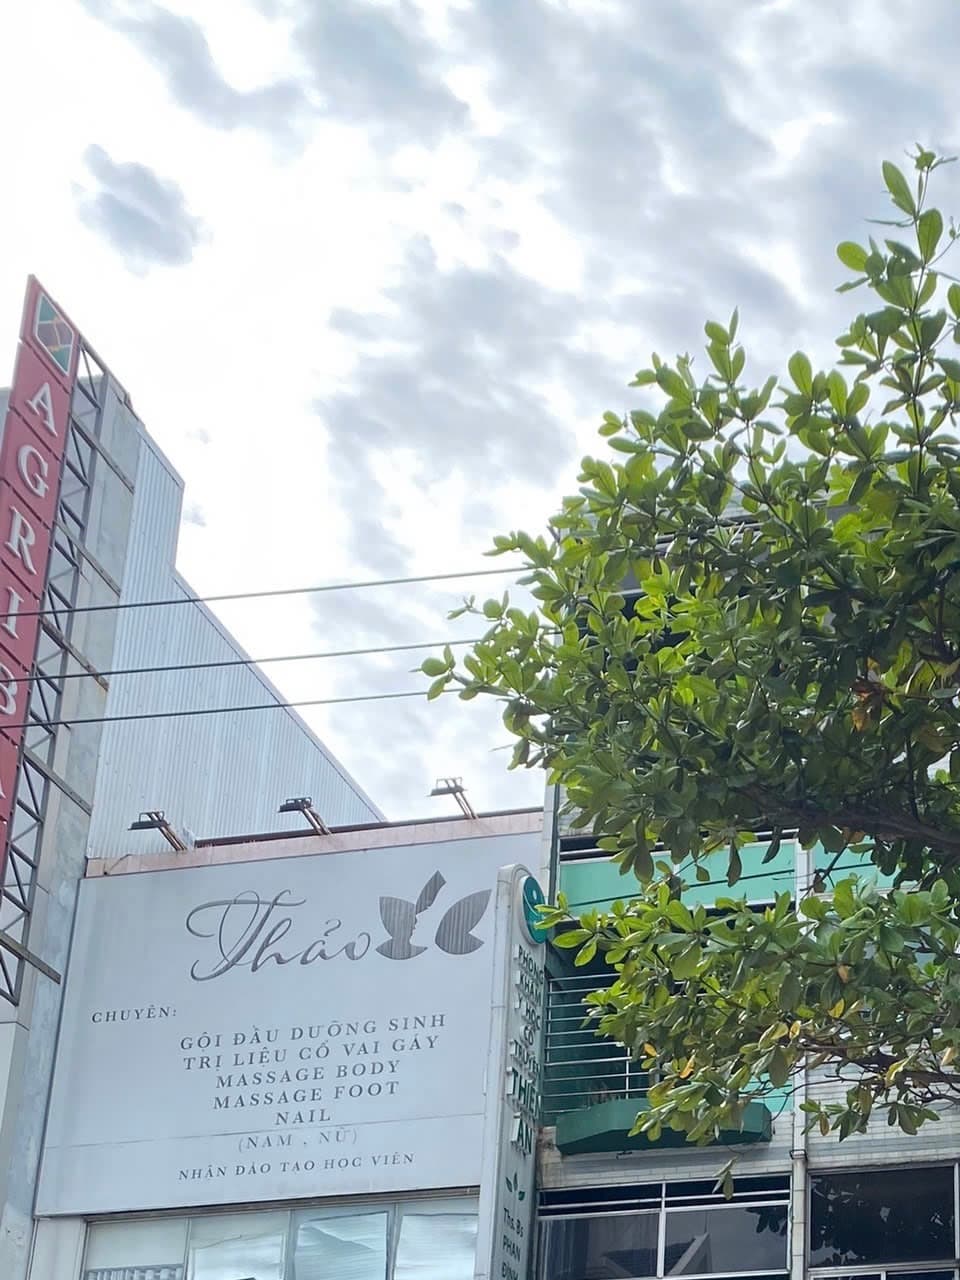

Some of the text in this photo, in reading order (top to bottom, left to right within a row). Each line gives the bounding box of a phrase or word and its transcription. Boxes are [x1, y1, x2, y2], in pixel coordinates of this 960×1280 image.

[91, 1004, 177, 1023] CHUYÊN:
[180, 1014, 446, 1051] GỘI ĐẦU DƯỠNG SINH
[183, 1055, 223, 1071] TRỊ
[233, 1046, 287, 1067] LIỆU
[342, 1041, 380, 1056] VAI
[391, 1033, 438, 1052] GÁY
[215, 1060, 400, 1089] MASSAGE BODY
[213, 1080, 400, 1109] MASSAGE FOOT
[275, 1108, 331, 1126] NAIL
